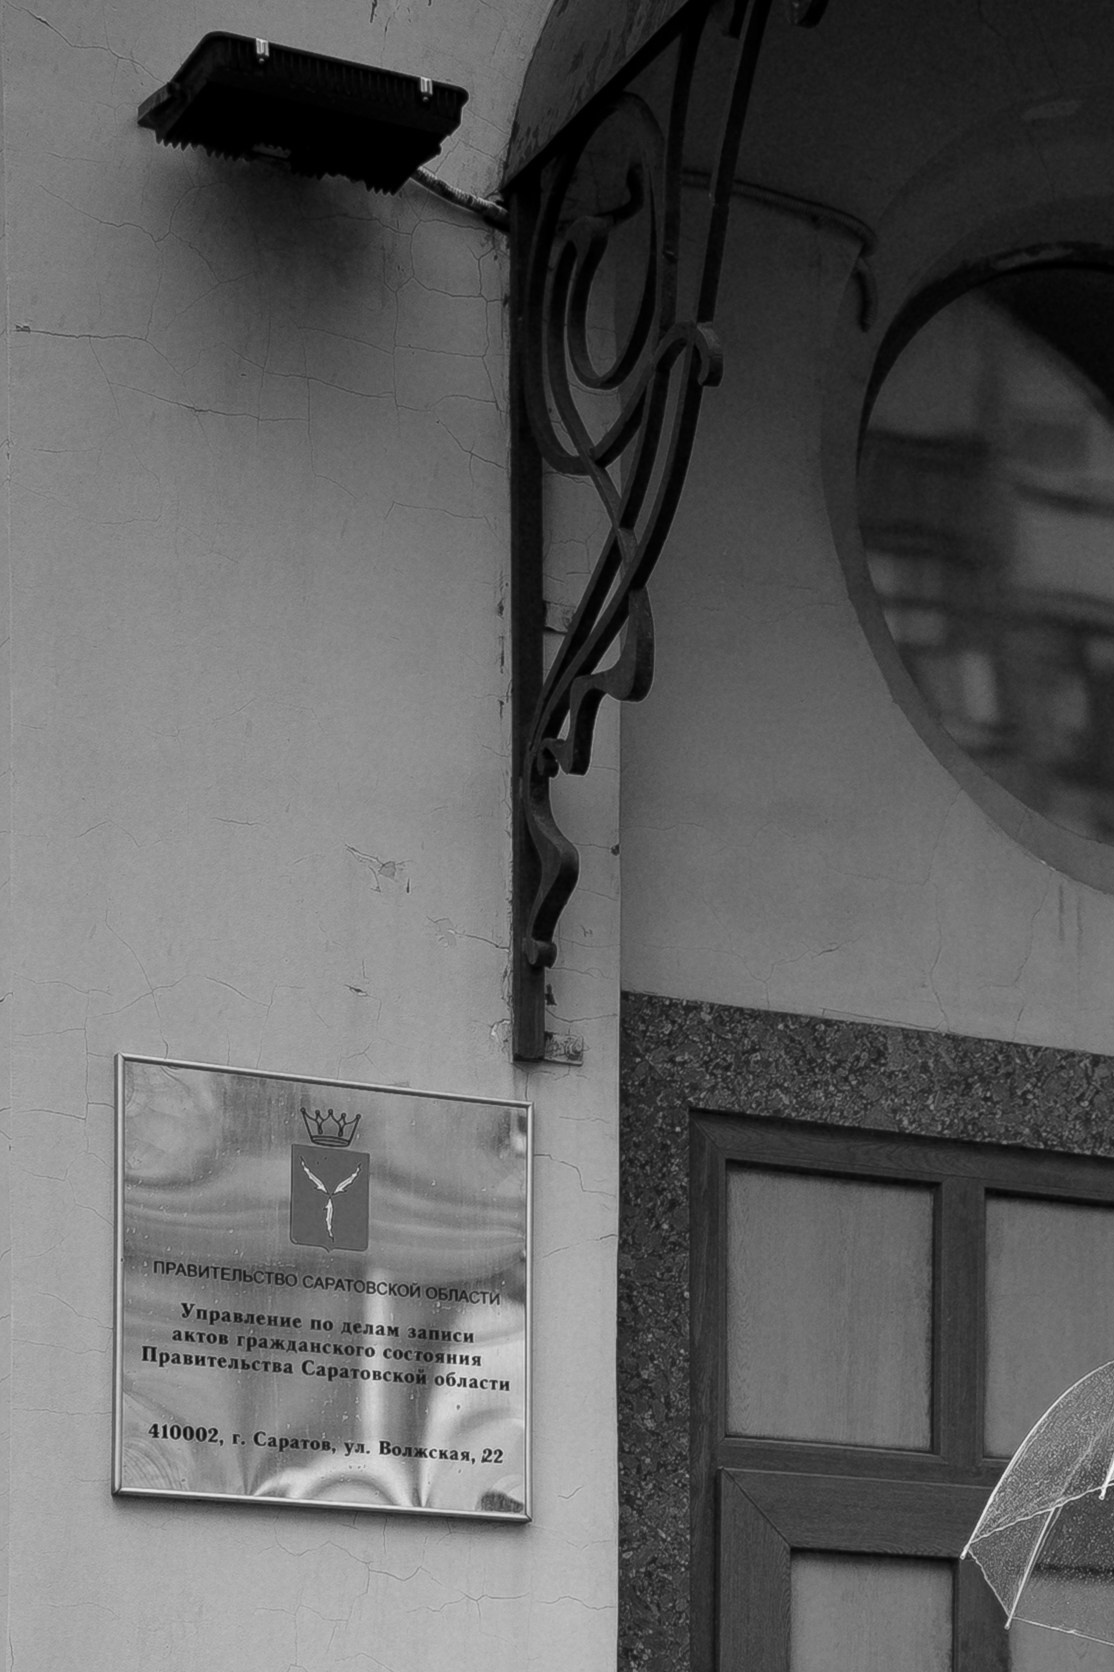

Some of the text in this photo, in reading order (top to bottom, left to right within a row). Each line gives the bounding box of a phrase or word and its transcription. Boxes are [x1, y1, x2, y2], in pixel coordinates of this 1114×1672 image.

[153, 1261, 501, 1305] ПРАВИТЕЛЬСТВО САРАТОВСКОЙ ОБЛАСТИ
[181, 1302, 475, 1343] Управление по делам записи
[172, 1329, 482, 1366] актов гражданского состояния
[141, 1346, 510, 1391] Правительства Саратовской области
[148, 1423, 504, 1464] 410002, г. Саратов, ул. Волжская, 22
